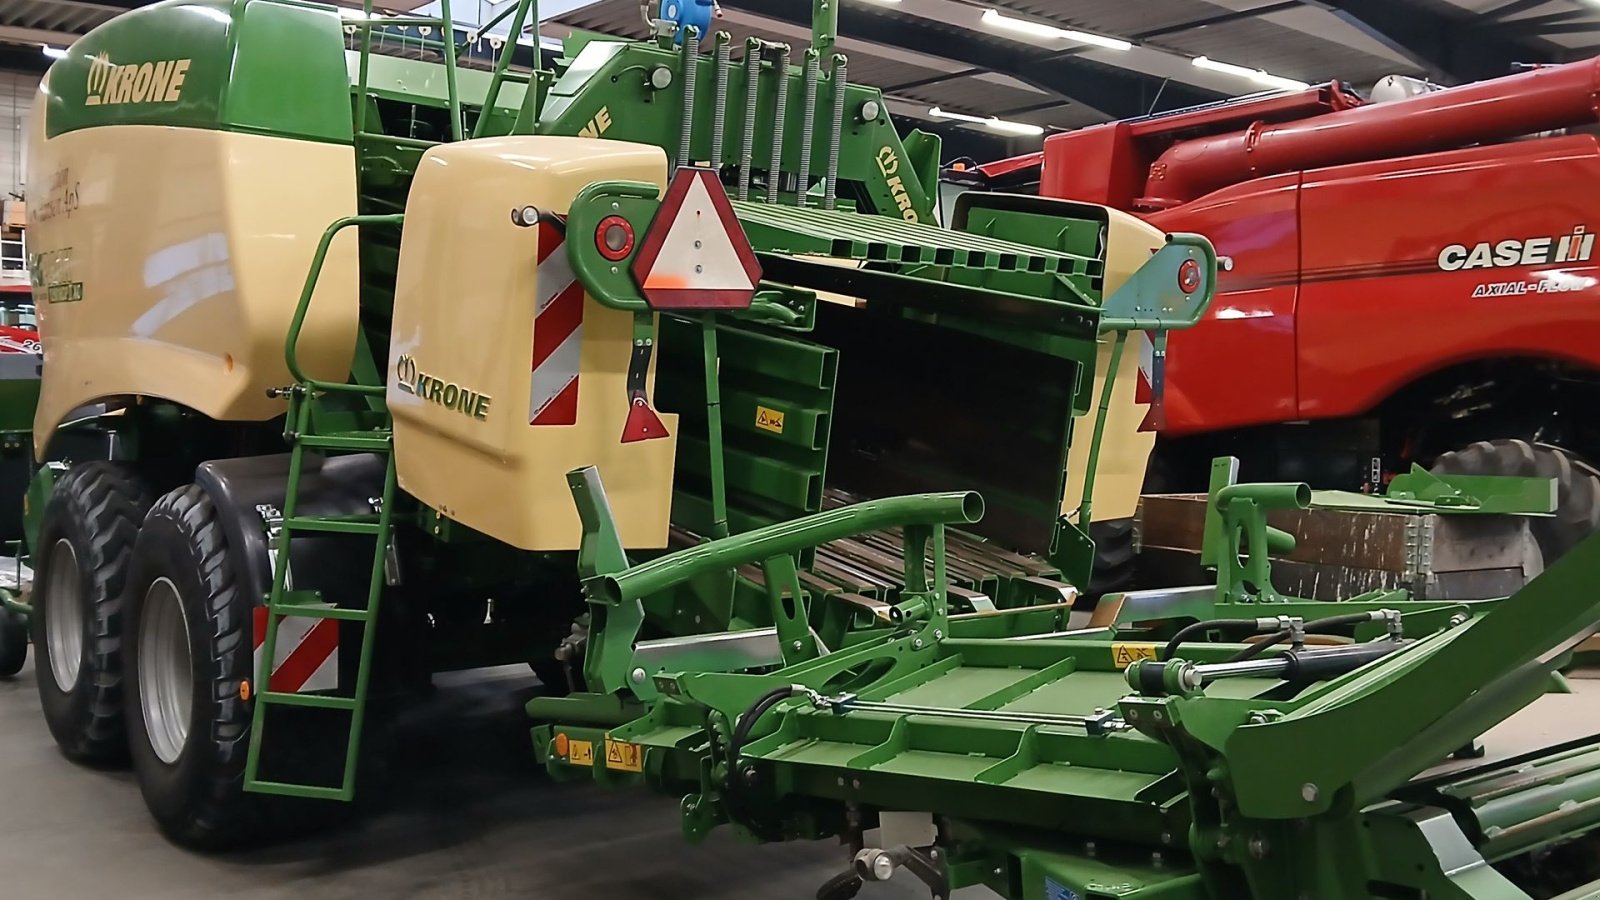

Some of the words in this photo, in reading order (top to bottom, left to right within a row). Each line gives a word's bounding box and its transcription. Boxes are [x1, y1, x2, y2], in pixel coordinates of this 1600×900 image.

[102, 59, 191, 104] KRONE
[886, 175, 919, 225] KRO
[1437, 237, 1551, 271] CASE
[1472, 278, 1586, 298] AXIAL-FLO
[416, 372, 491, 421] KRONE
